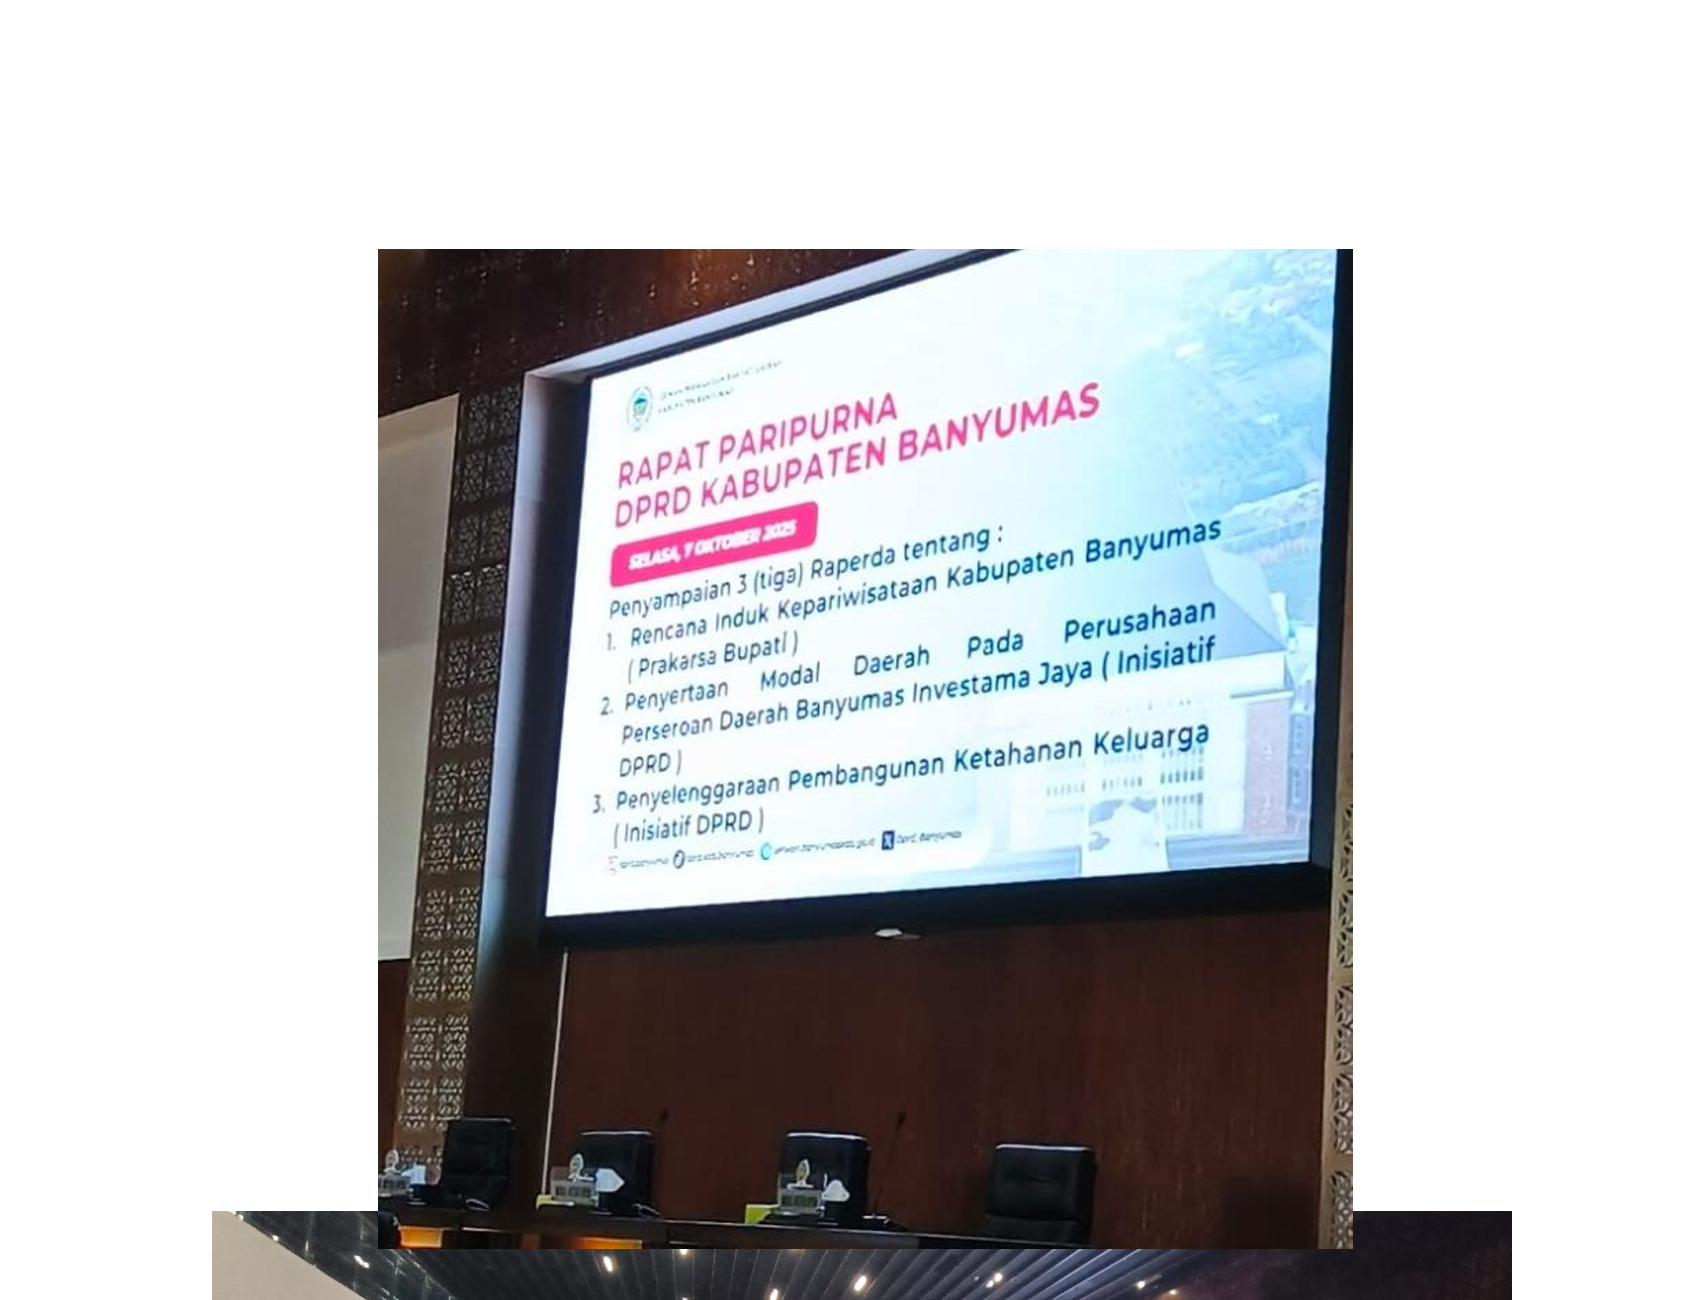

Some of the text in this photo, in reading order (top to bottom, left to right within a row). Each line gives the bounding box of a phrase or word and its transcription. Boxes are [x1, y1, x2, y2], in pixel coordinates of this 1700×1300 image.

[615, 382, 1100, 528] DPRD KABUPATEN BANYUMAS
[618, 441, 709, 489] RAPAT
[719, 393, 897, 463] PARIPURNA
[609, 579, 730, 619] Penyampaian
[737, 574, 747, 594] 3
[754, 563, 803, 597] (tiga)
[811, 544, 896, 582] Raperda
[903, 527, 990, 560] tentang
[630, 618, 707, 648] Rencana
[715, 605, 769, 632] Induk
[777, 574, 937, 621] Kepariwisataan
[947, 547, 1074, 589] Kabupaten
[1085, 520, 1221, 563] Banyumas
[694, 527, 761, 556] OKTOBER
[621, 716, 713, 744] Perseroan
[720, 701, 788, 731] Daerah
[796, 687, 904, 721] Banyumas
[912, 668, 1030, 704] Investama
[1038, 659, 1093, 687] Jaya
[1118, 635, 1216, 674] Inisiatif
[624, 680, 728, 713] Penyertaan
[760, 662, 820, 690] Modal
[854, 645, 930, 676] Daerah
[967, 629, 1024, 658] Pada
[1064, 601, 1216, 643] Perusahaan
[638, 648, 717, 678] Prakarsa
[724, 631, 787, 663] Bupati
[616, 776, 780, 812] Penyelenggaraan
[788, 754, 944, 791] Pembangunan
[953, 739, 1083, 772] Ketahanan
[1093, 724, 1210, 755] Keluarga
[619, 752, 671, 778] DPRD
[624, 815, 691, 843] Inisiatif
[696, 810, 752, 835] DPRD
